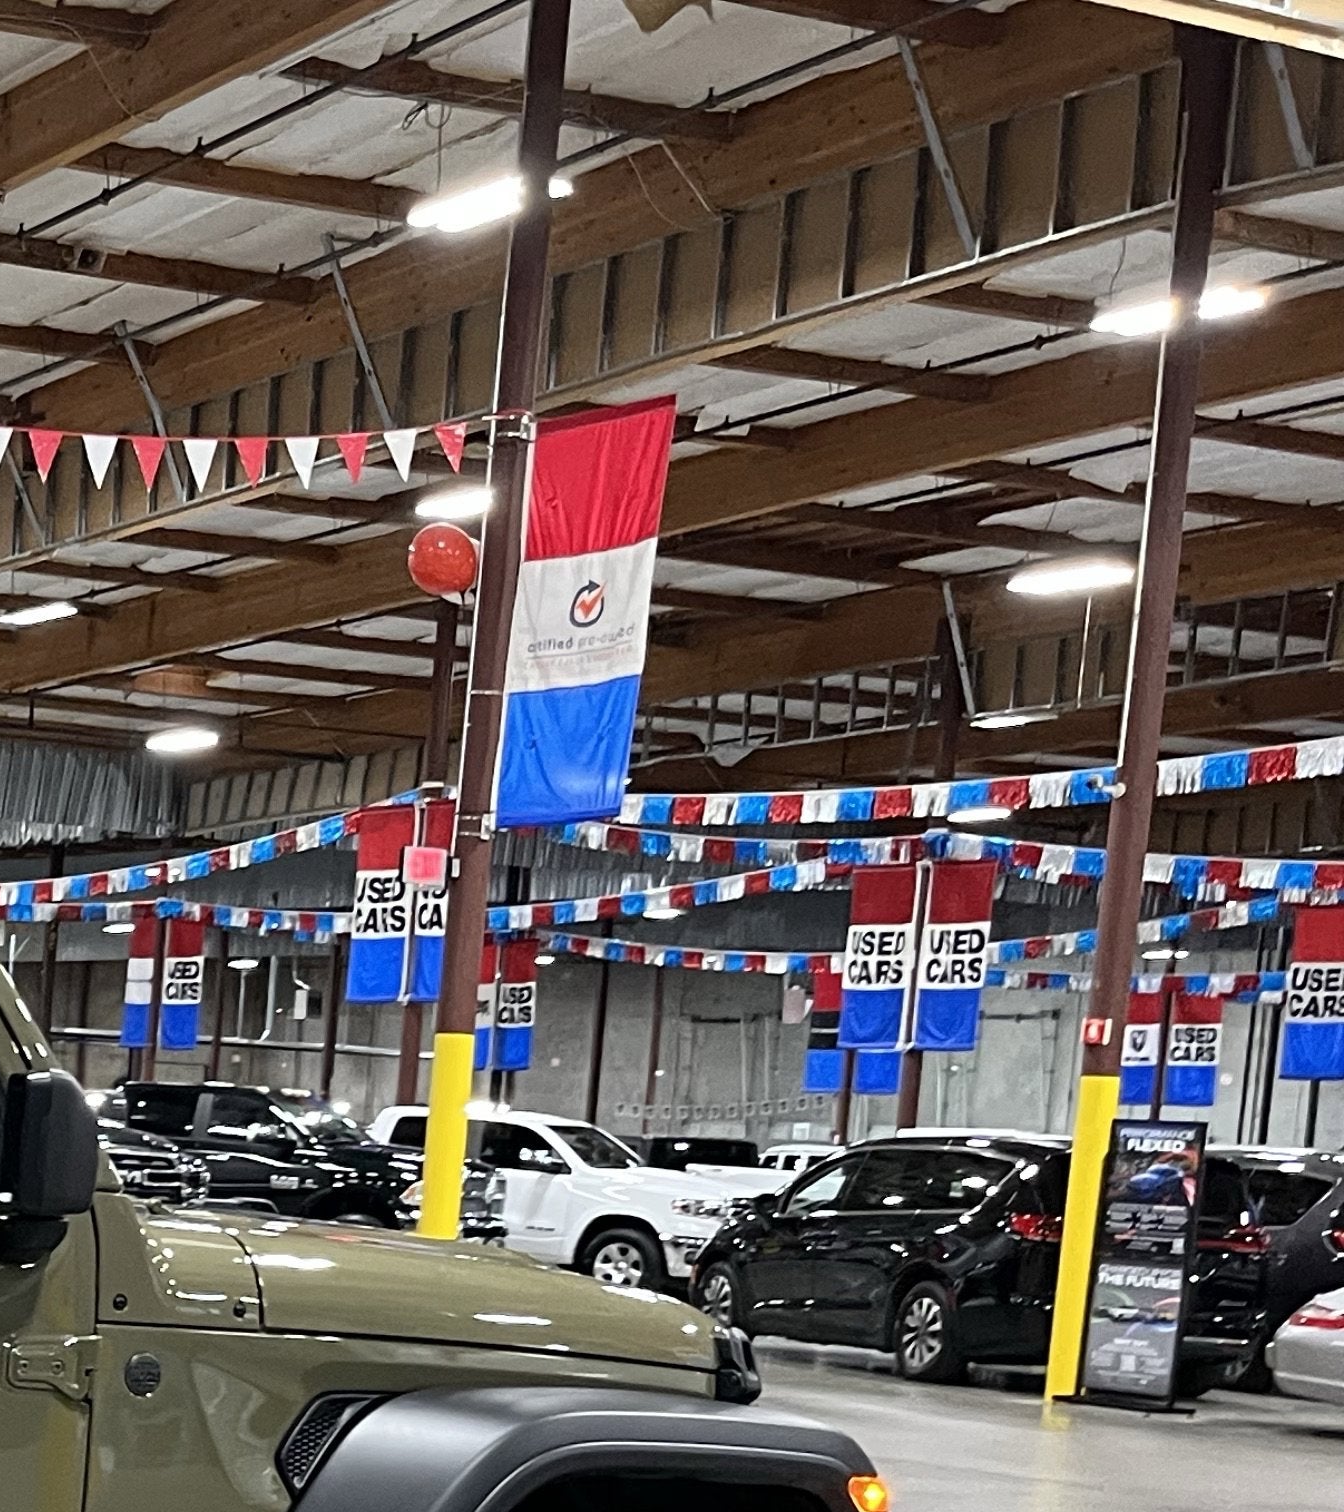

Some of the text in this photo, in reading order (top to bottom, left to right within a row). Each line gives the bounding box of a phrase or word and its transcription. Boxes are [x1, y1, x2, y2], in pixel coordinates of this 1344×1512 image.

[852, 931, 905, 956] USED
[848, 959, 903, 984] CARS
[926, 957, 983, 983] CARS
[1291, 967, 1344, 992] USE
[1174, 1027, 1218, 1043] USED
[1170, 1046, 1216, 1062] CARS
